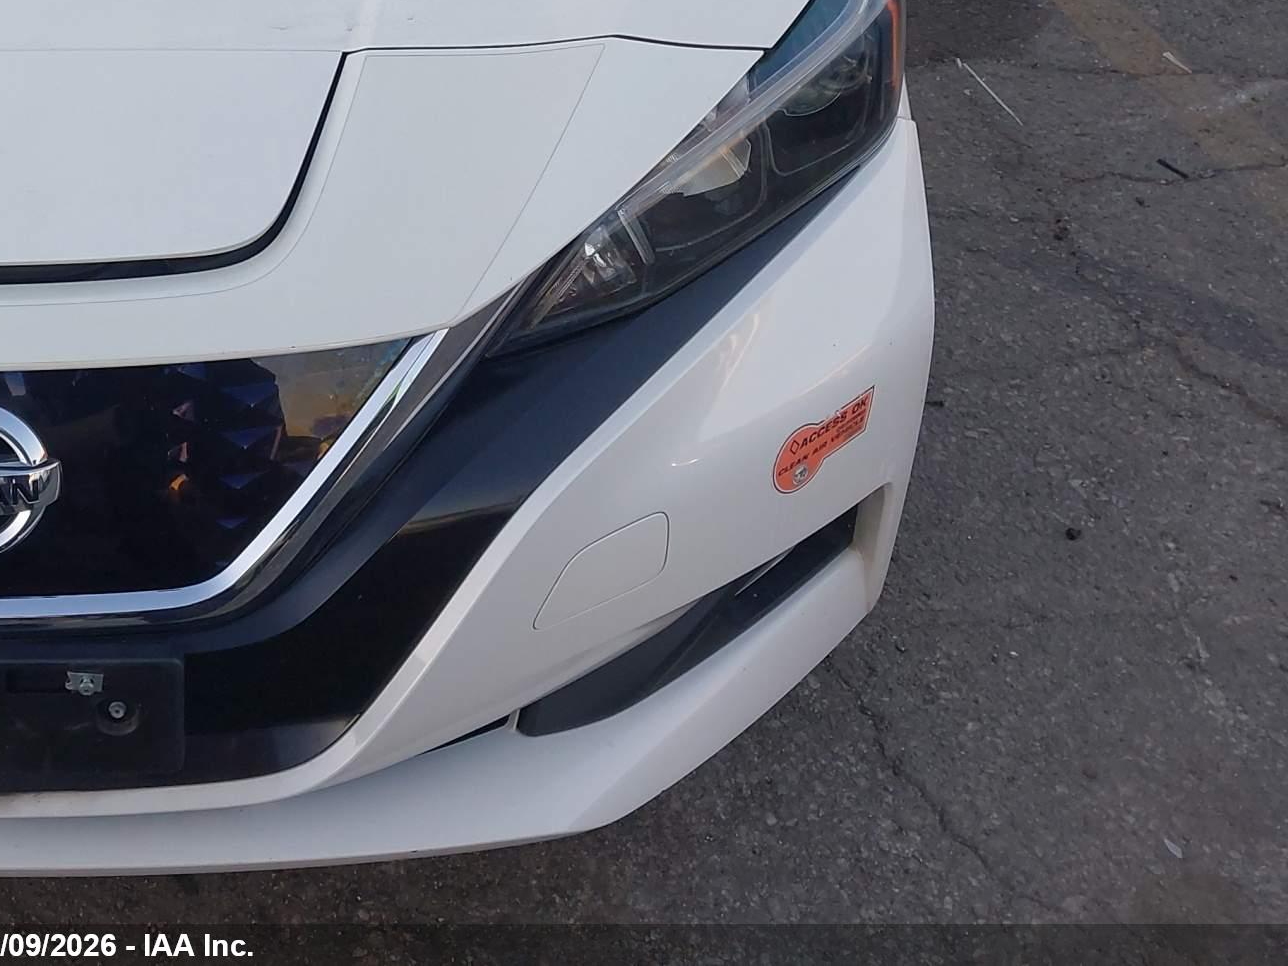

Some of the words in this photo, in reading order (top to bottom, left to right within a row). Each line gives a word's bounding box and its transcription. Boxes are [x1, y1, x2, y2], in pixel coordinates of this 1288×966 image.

[800, 411, 848, 450] ACCESS
[851, 395, 871, 415] OK
[777, 452, 811, 477] CLEAN
